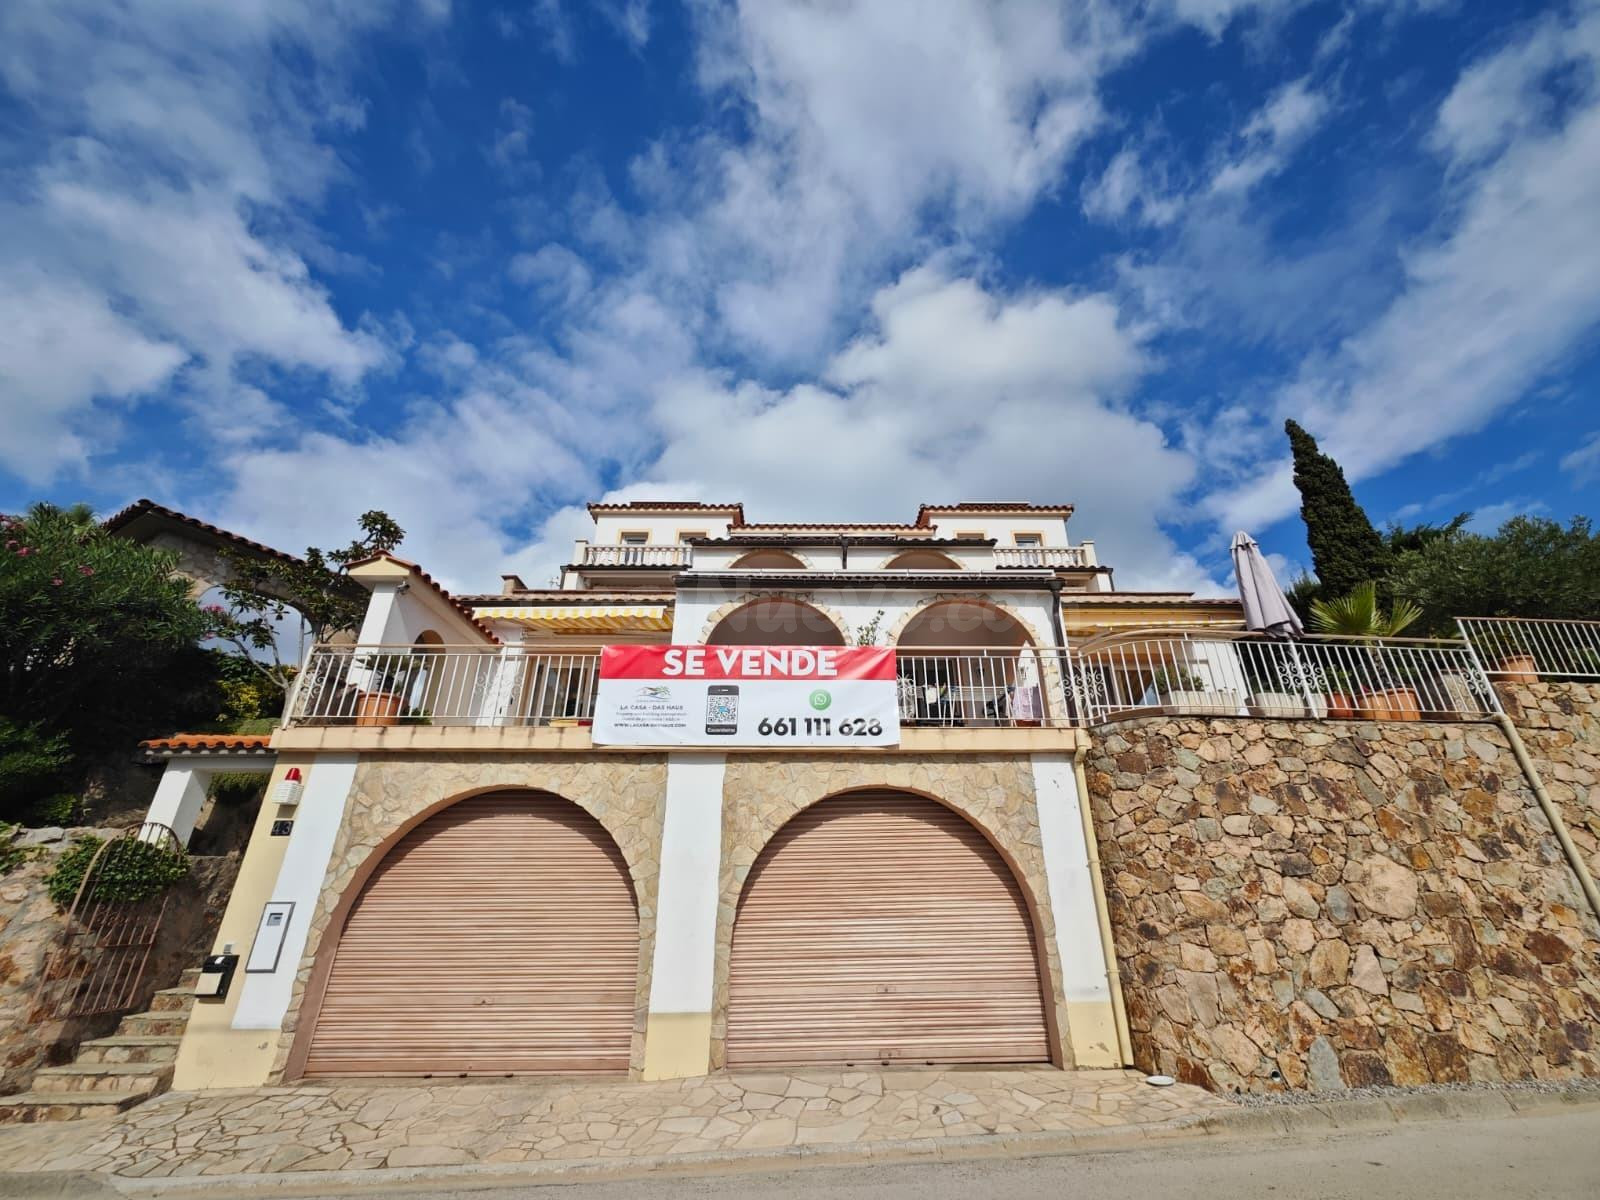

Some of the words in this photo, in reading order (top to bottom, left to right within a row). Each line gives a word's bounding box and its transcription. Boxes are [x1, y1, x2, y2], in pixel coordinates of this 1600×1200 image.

[662, 649, 706, 676] SE
[716, 649, 837, 676] VENDE
[757, 717, 796, 736] 661
[804, 717, 831, 736] 111
[838, 717, 883, 736] 628
[272, 821, 292, 835] 43
